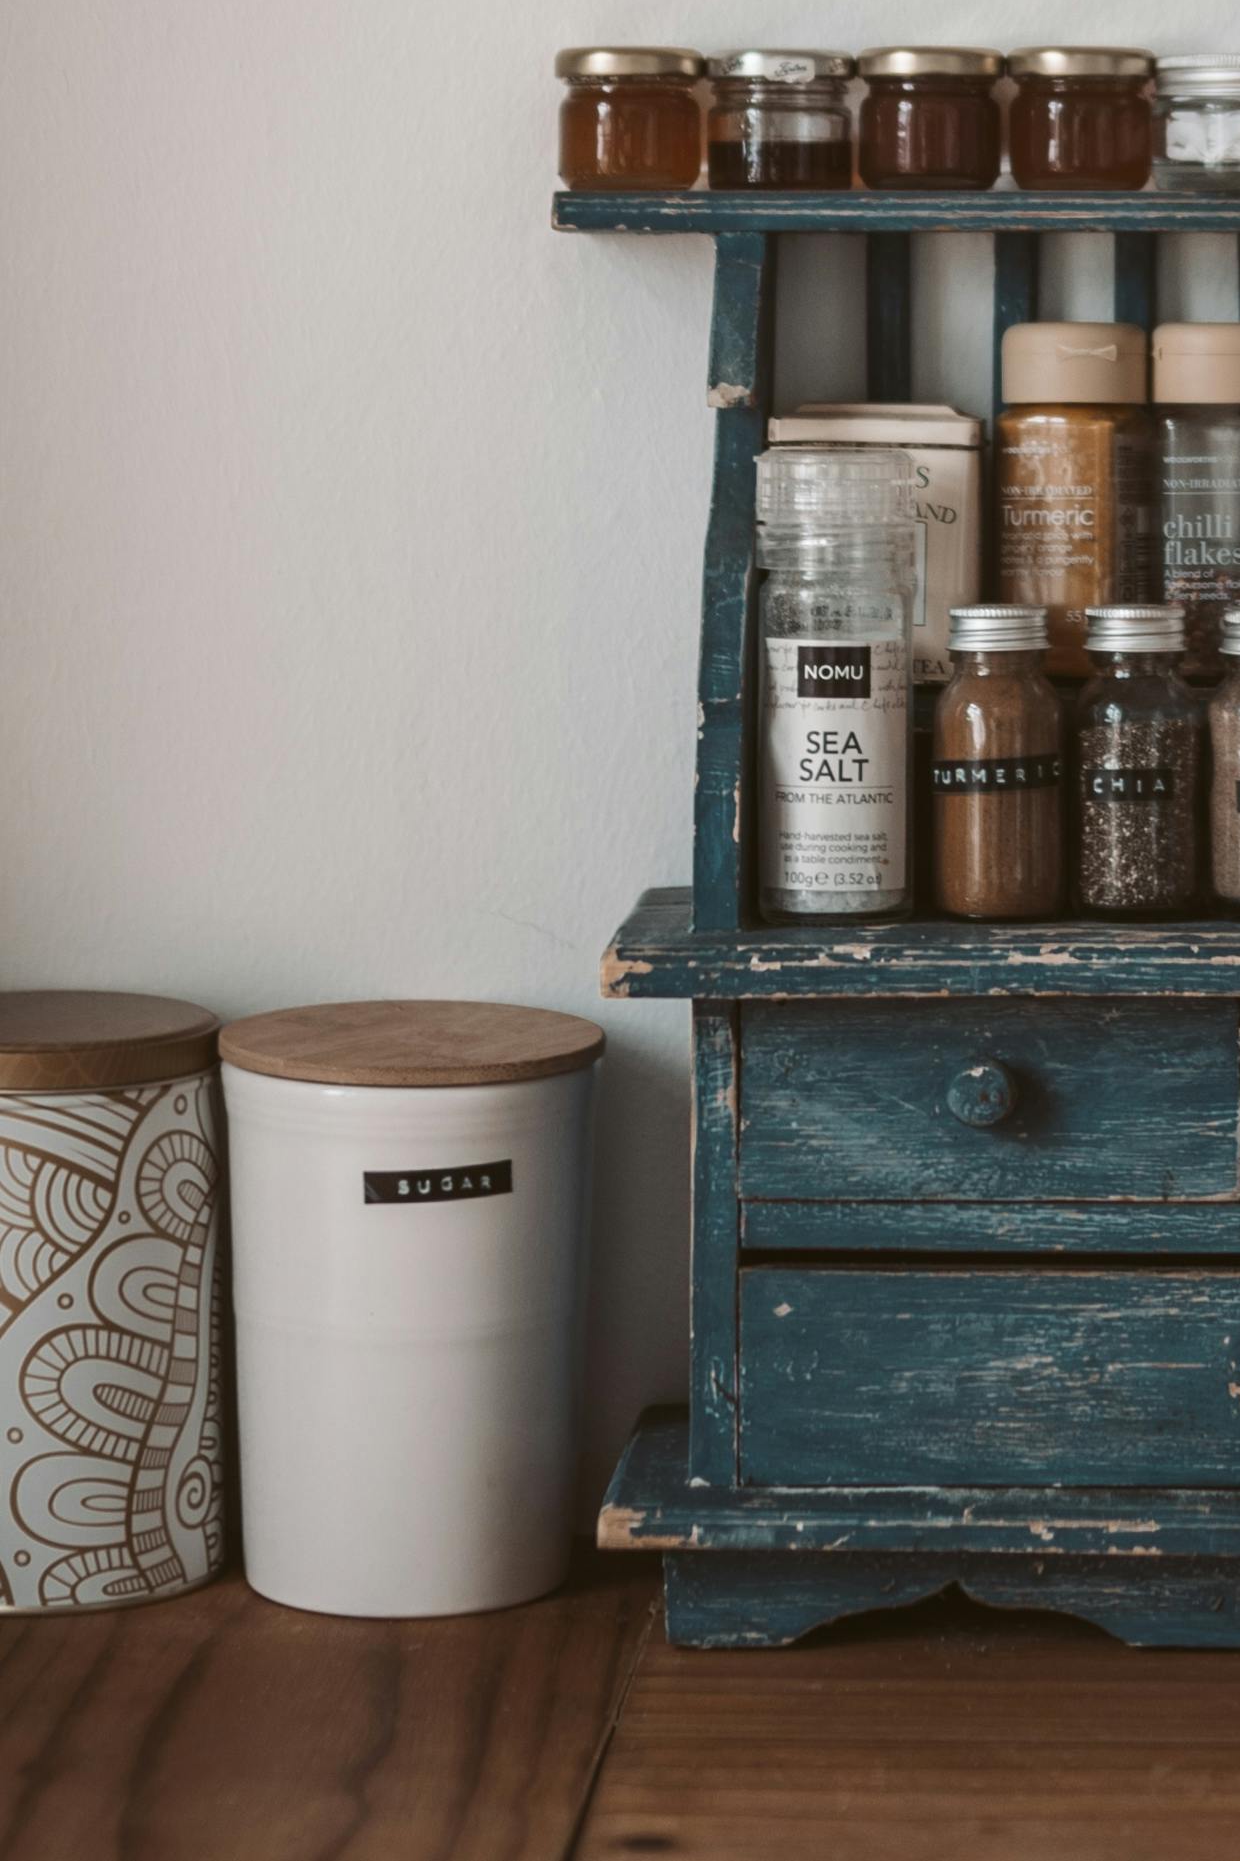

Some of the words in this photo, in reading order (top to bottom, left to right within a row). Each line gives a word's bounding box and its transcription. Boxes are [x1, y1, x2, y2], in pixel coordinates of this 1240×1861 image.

[1002, 504, 1095, 526] Turmeric
[1163, 514, 1233, 539] chilli
[803, 664, 864, 680] NOMU
[806, 731, 863, 755] SEA
[799, 758, 869, 782] SALT
[934, 760, 1061, 785] TURMERIC
[1093, 778, 1166, 794] CHIA
[775, 791, 806, 804] FROM
[809, 793, 833, 805] THE
[835, 792, 894, 805] ATLANTIC
[854, 833, 870, 841] sea
[795, 843, 827, 854] during
[829, 843, 868, 853] cooking
[870, 843, 887, 852] and
[801, 854, 826, 864] table
[785, 871, 813, 888] 100g
[397, 1175, 492, 1195] SUGAR
